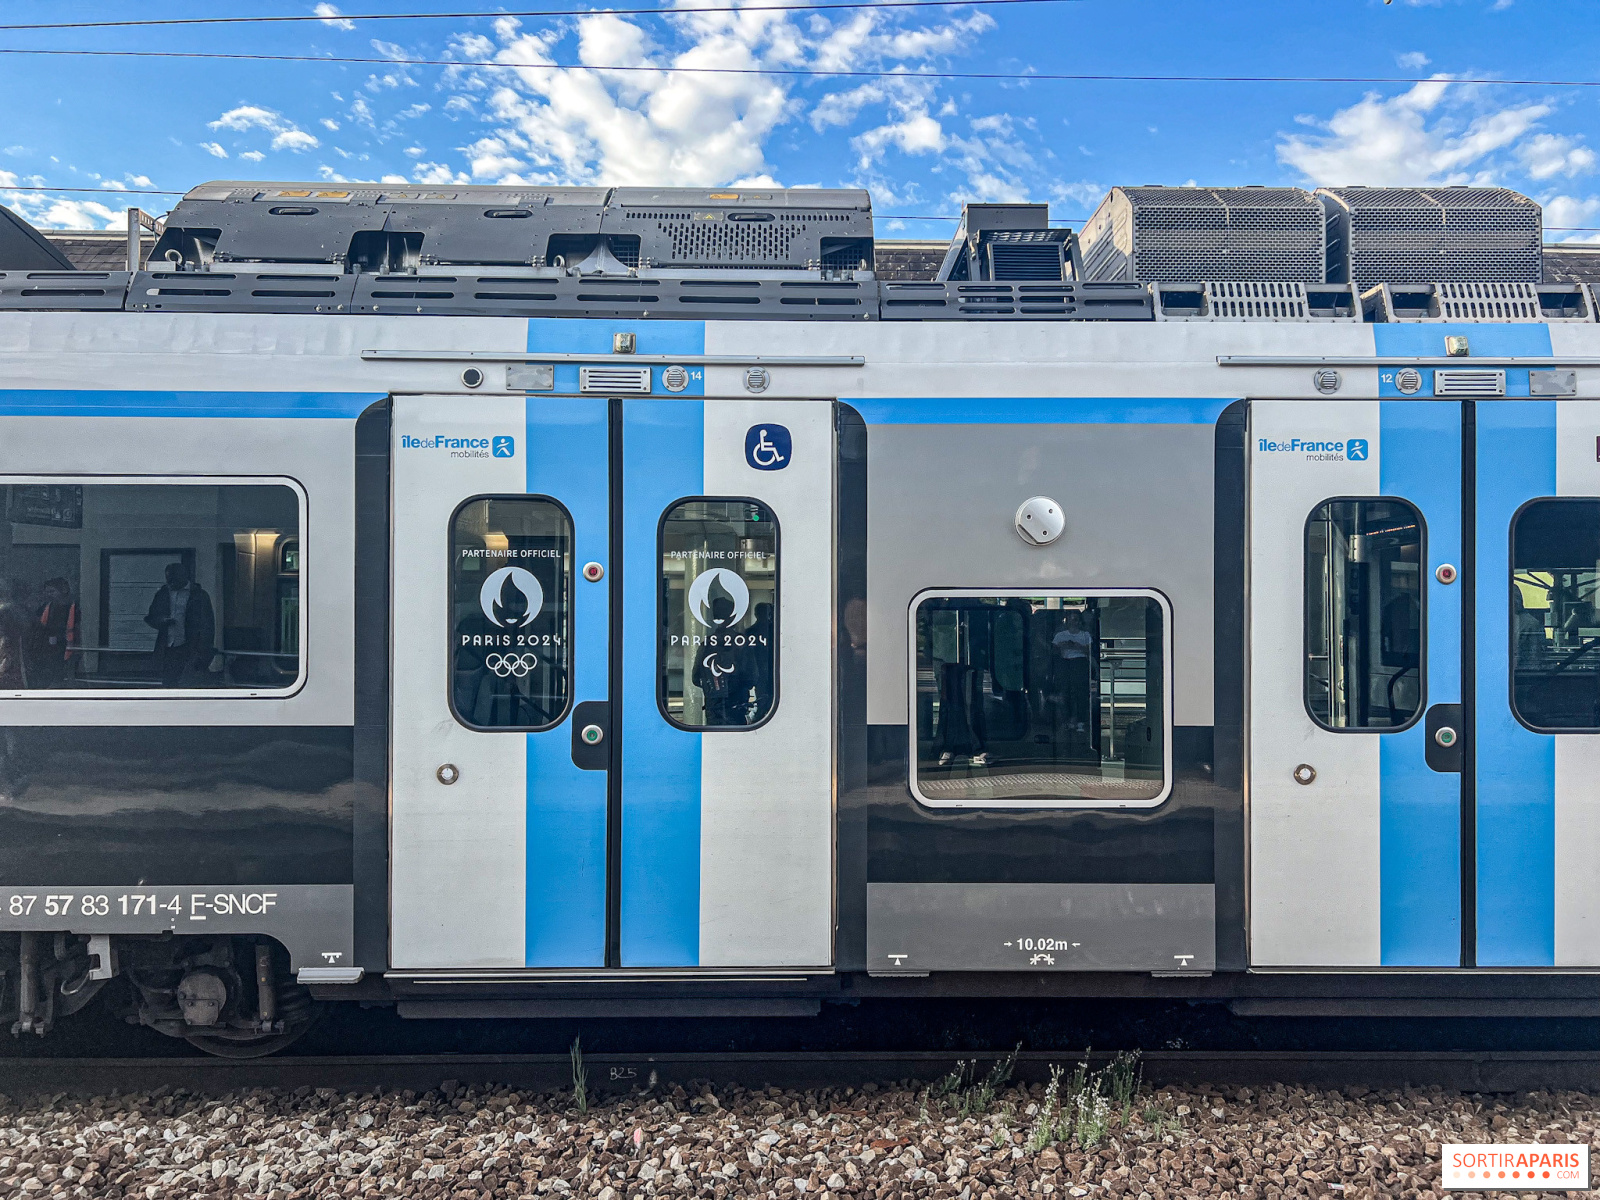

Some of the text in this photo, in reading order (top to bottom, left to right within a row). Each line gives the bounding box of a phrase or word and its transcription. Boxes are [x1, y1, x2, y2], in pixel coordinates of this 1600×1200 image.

[691, 370, 703, 382] 14
[1380, 373, 1393, 384] 12
[450, 449, 490, 459] mobilités
[1305, 453, 1344, 462] mobilités
[462, 549, 561, 558] PARTENAIRE OFFICIEL
[670, 550, 766, 560] PARTENAIRE OFFICIEL
[517, 634, 562, 647] 2024
[724, 634, 767, 647] 2024
[9, 894, 38, 916] 87
[44, 894, 74, 916] 57
[81, 894, 110, 916] 83
[117, 894, 182, 916] 171-4
[1016, 937, 1068, 951] 10.02m
